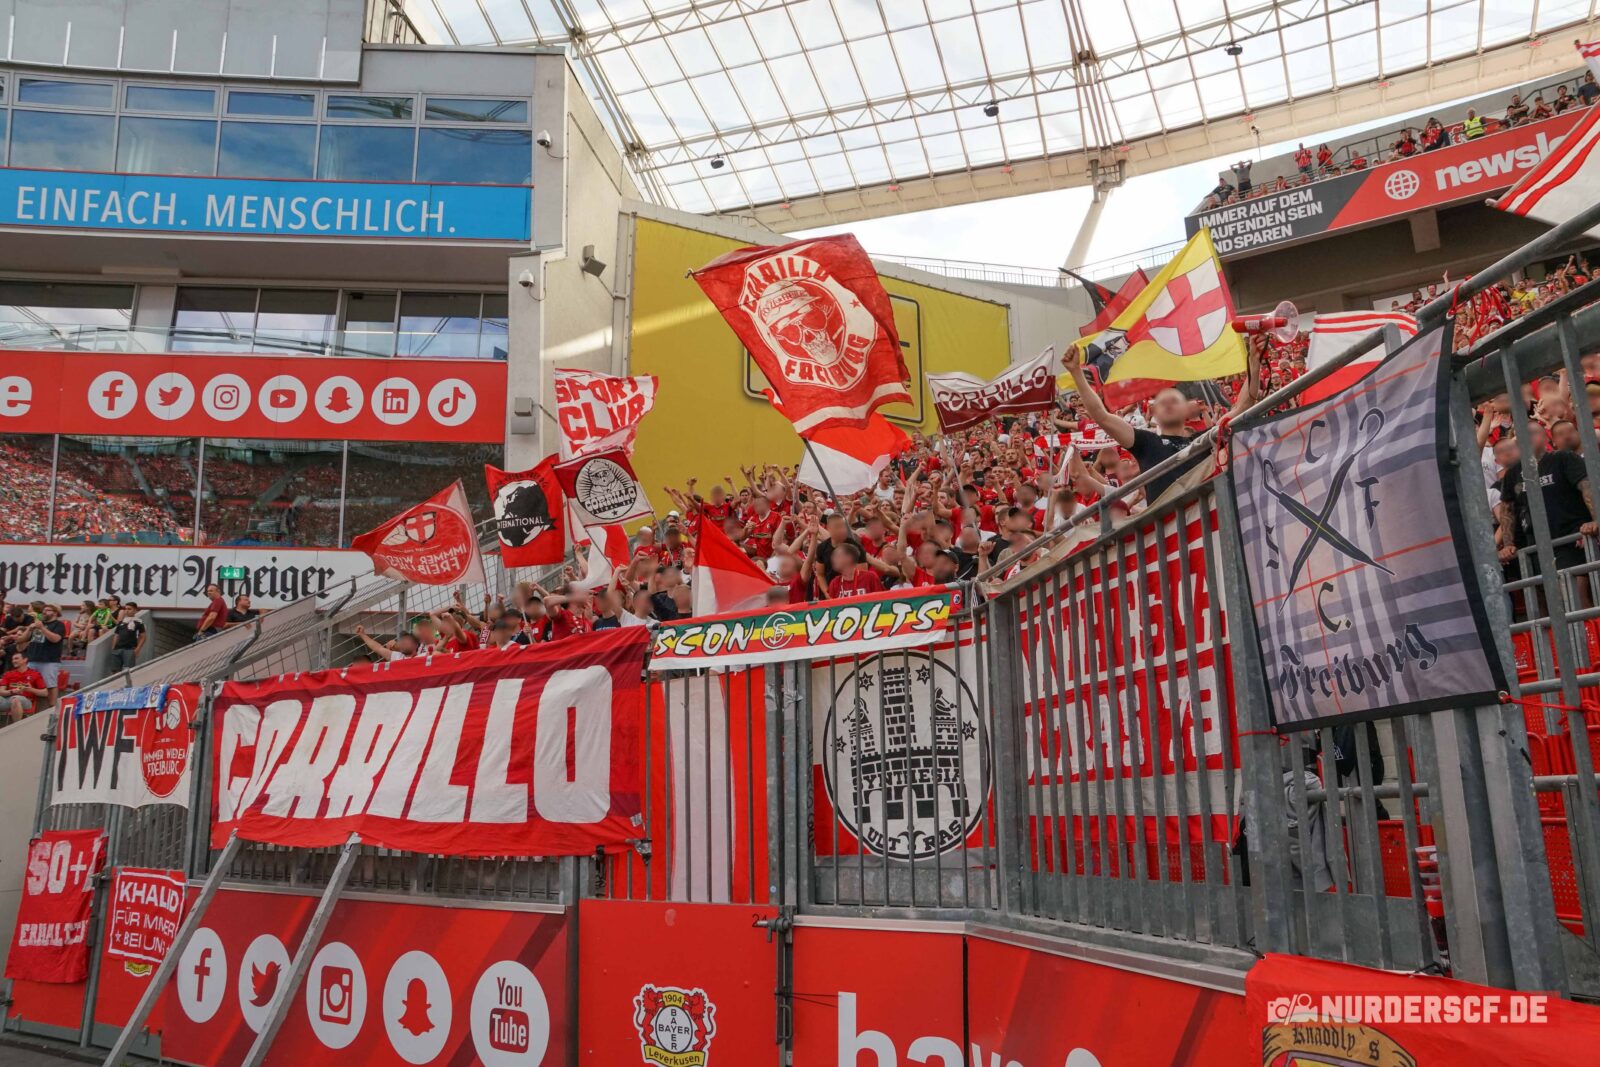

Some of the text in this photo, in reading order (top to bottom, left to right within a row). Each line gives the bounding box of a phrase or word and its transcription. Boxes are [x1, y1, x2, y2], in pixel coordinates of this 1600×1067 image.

[1435, 132, 1565, 191] newsl
[16, 186, 456, 233] EINFACH. MENSCHLICH.
[1199, 189, 1313, 229] IMMER AUF DEM
[1209, 201, 1323, 239] AUFENDEN SEIN
[1214, 224, 1292, 253] ND SPAREN
[804, 599, 945, 645] VOLTS
[1279, 622, 1439, 700] Freiburg
[218, 665, 613, 824] CORRILLO
[119, 881, 179, 913] KHALID
[115, 907, 140, 926] FÜR
[124, 931, 141, 947] BEI
[497, 977, 523, 1008] You
[664, 994, 683, 1005] 1904
[492, 1014, 527, 1047] Tube
[658, 1024, 690, 1035] BAYER
[670, 1008, 678, 1051] BAYER
[648, 1048, 700, 1066] Leverkusen
